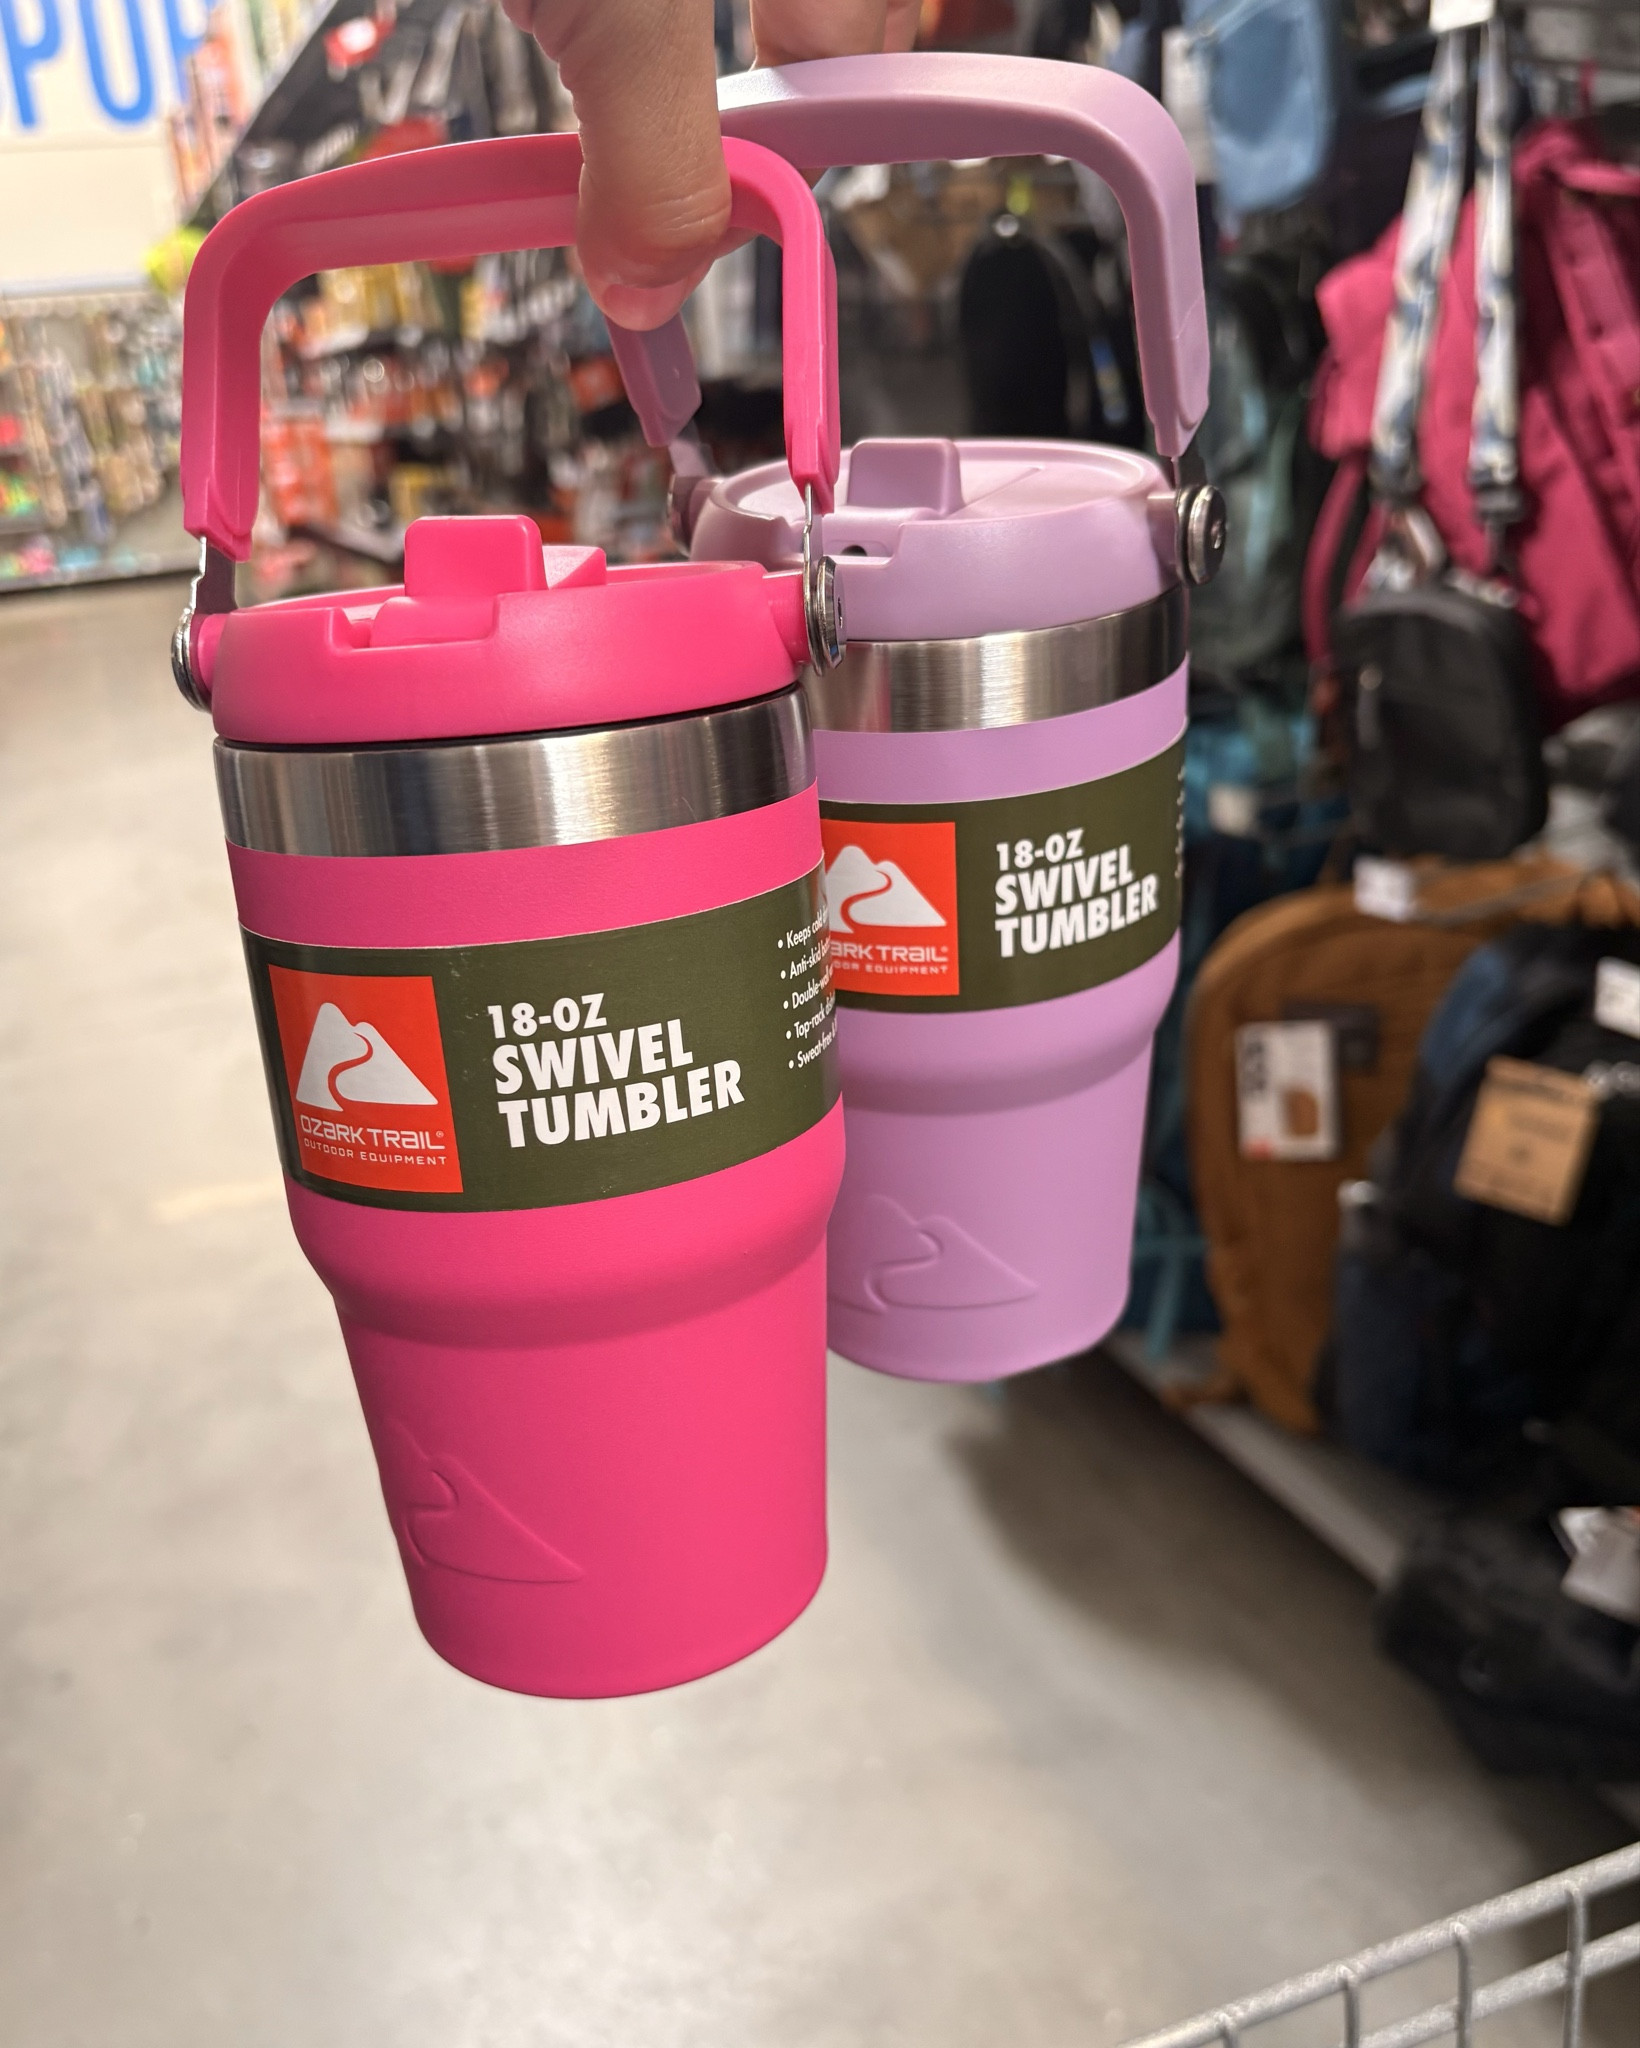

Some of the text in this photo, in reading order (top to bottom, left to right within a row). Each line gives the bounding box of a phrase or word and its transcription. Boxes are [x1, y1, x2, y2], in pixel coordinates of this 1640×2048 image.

[996, 827, 1085, 872] 18-OZ
[995, 844, 1134, 916] SWIVEL
[995, 873, 1159, 959] TUMBLER
[786, 929, 812, 949] Keeps
[789, 942, 821, 980] Anti-skid
[865, 963, 949, 975] EQUIPMENT
[487, 992, 608, 1039] 18-OZ
[793, 1002, 826, 1039] Top-rack
[492, 1018, 694, 1095] SWIVEL
[797, 1031, 833, 1069] Sweat-free
[497, 1059, 745, 1149] TUMBLER
[303, 1137, 447, 1166] OUTDOOR EQUIPMENT
